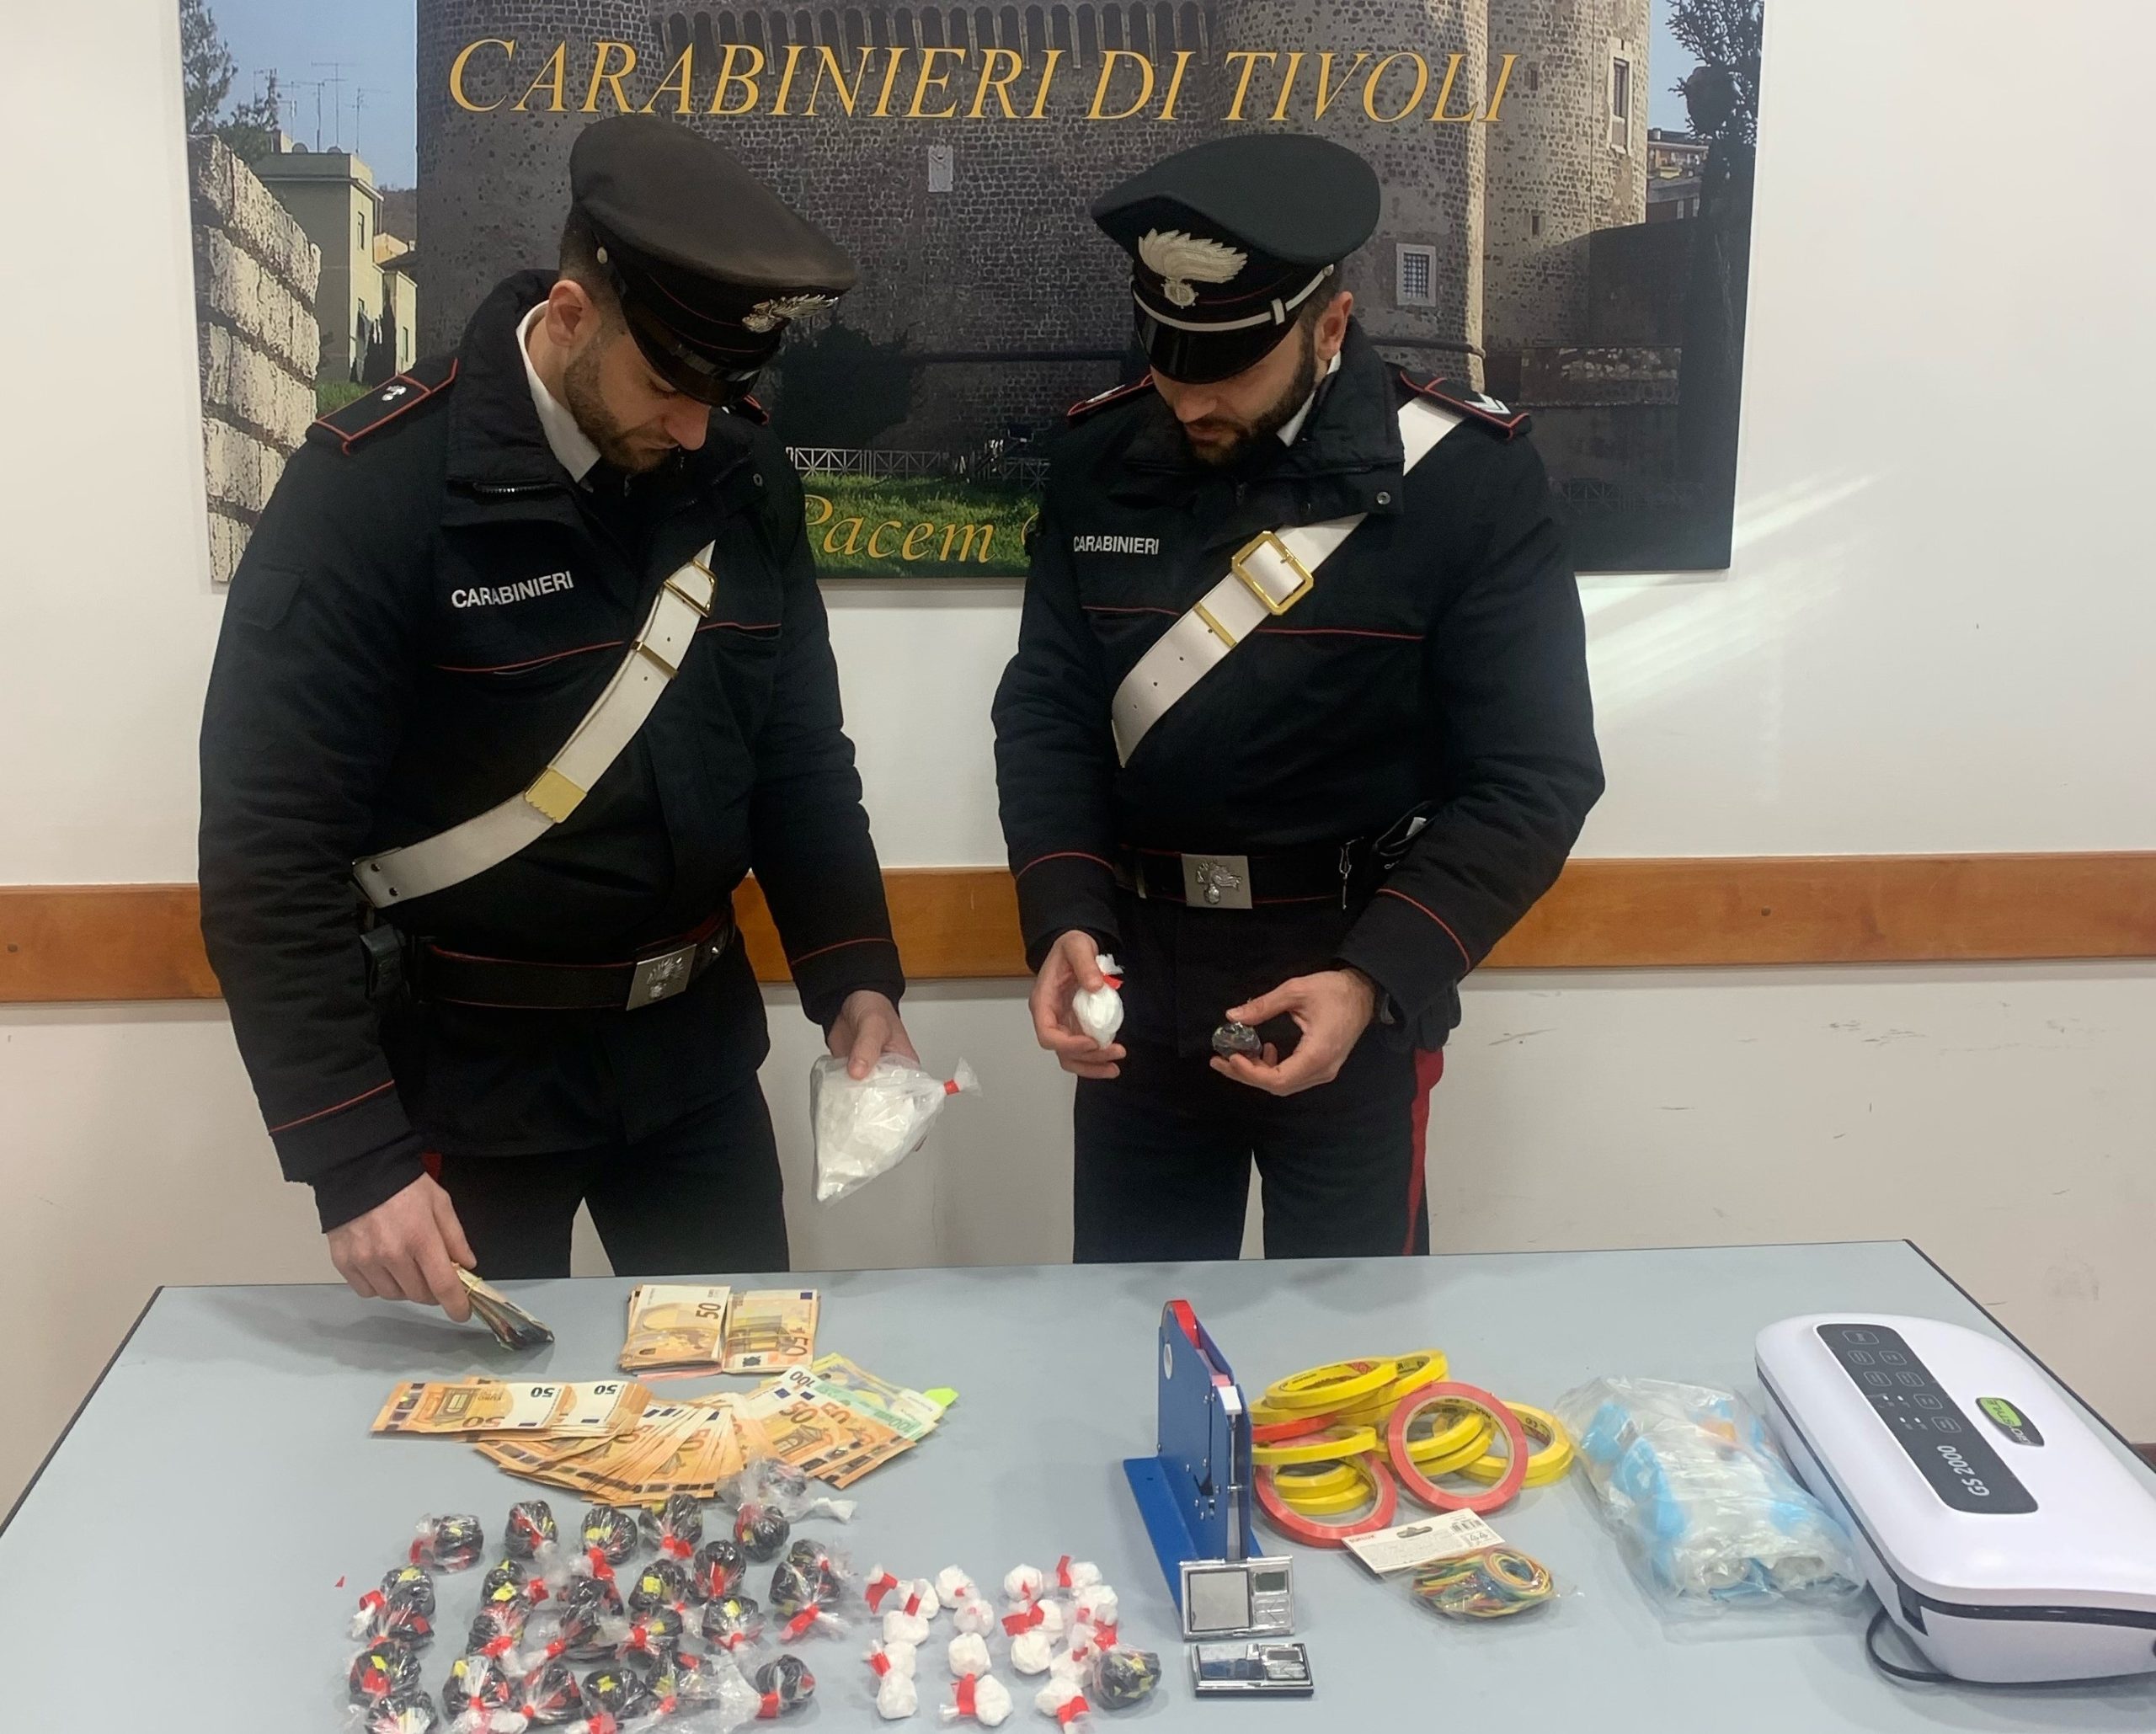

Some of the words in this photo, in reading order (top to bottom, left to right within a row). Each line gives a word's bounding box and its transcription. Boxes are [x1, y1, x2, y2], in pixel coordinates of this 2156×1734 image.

[449, 38, 1067, 120] CARABINIERI
[1081, 49, 1196, 122] DI
[1219, 50, 1521, 124] TIVOLI
[1072, 535, 1160, 555] CARABINIERI
[450, 570, 574, 609] CARABINIERI
[696, 1302, 722, 1321] 50
[530, 1386, 556, 1398] 50
[594, 1385, 618, 1395] 50
[1935, 1444, 1975, 1475] 2000
[1961, 1477, 1990, 1497] GS
